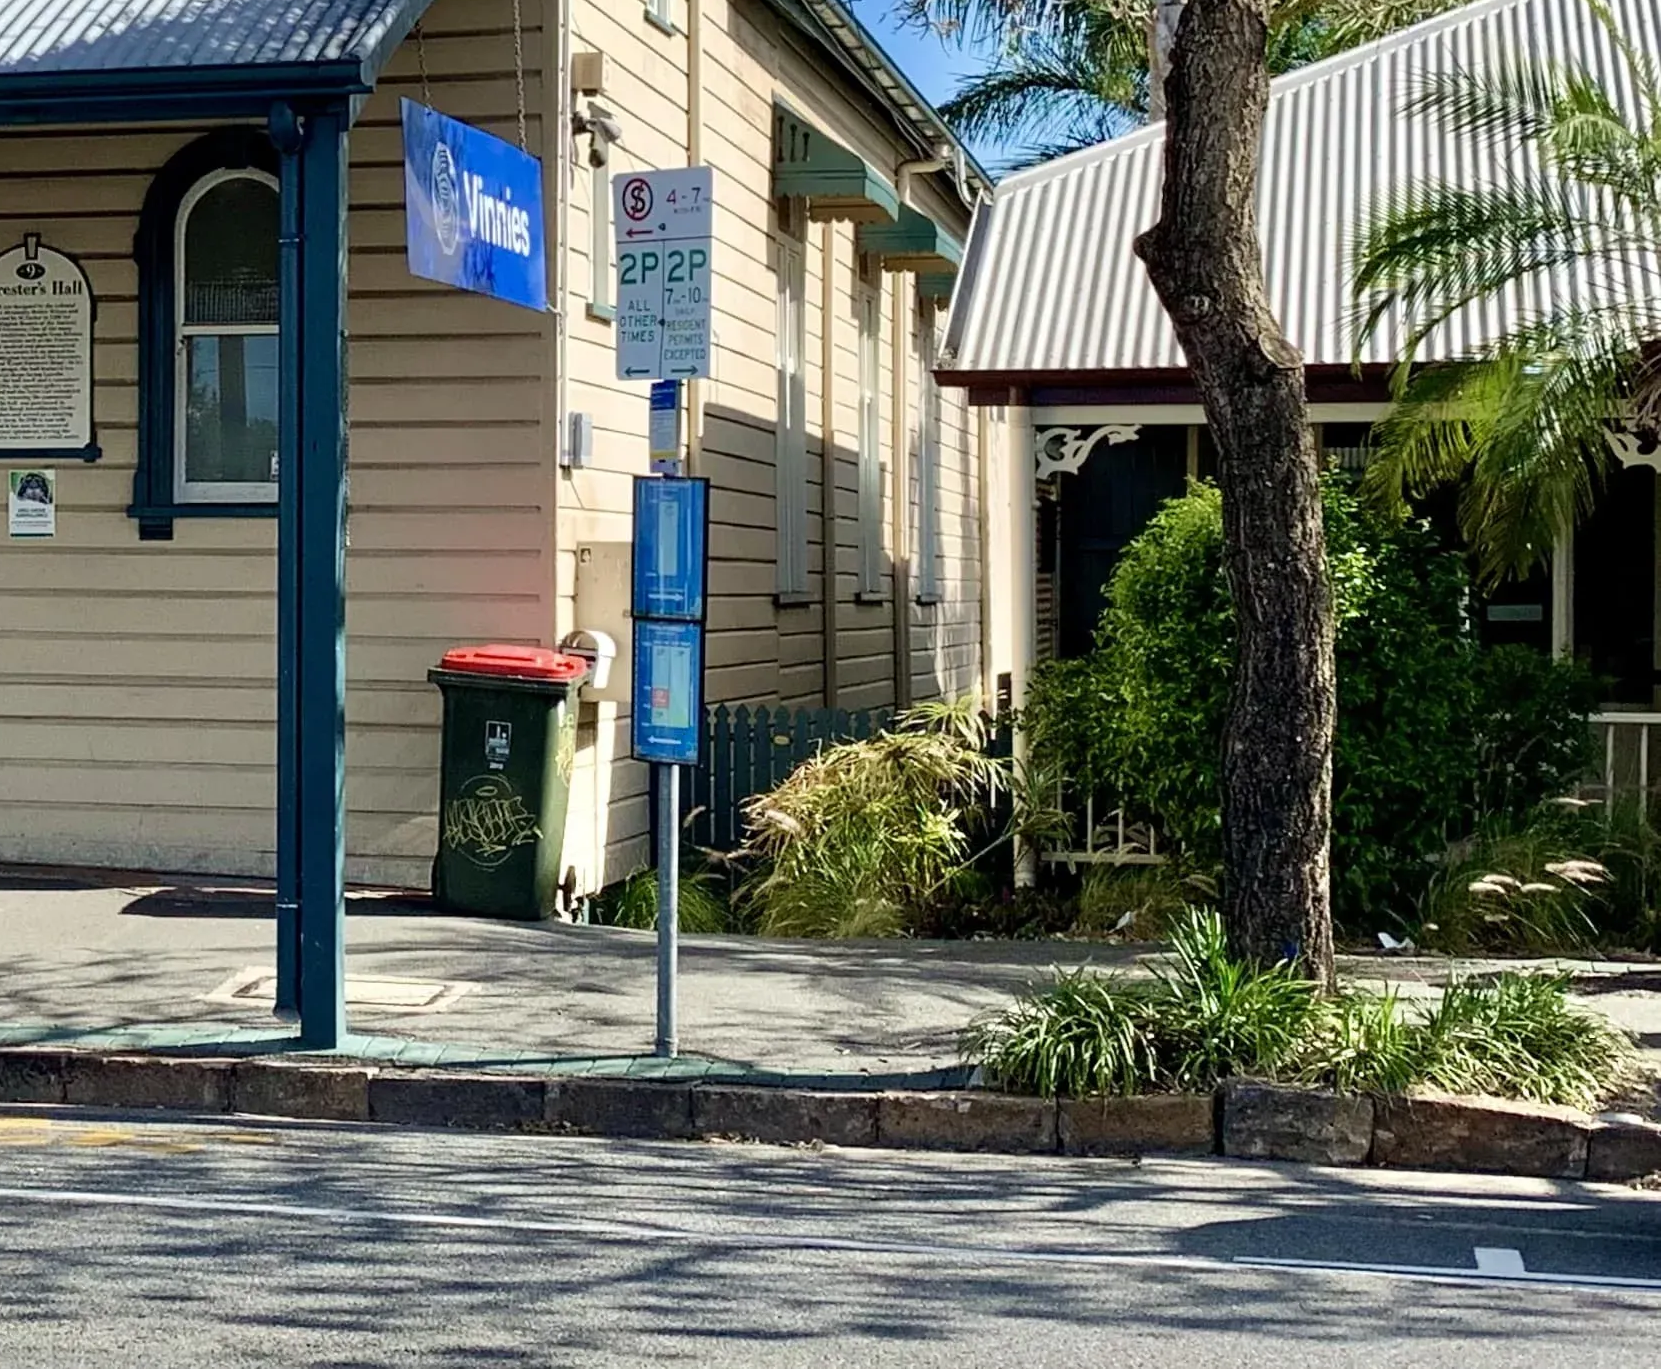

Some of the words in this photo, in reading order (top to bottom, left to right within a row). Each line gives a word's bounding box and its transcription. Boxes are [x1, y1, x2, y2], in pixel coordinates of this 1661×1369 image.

[462, 169, 531, 258] Vinnies
[25, 263, 36, 279] 9
[619, 251, 660, 285] 2P
[666, 248, 708, 283] 2P
[52, 280, 83, 296] Hall
[628, 299, 651, 312] ALL
[619, 314, 658, 328] OTHER
[621, 330, 655, 343] TIMES
